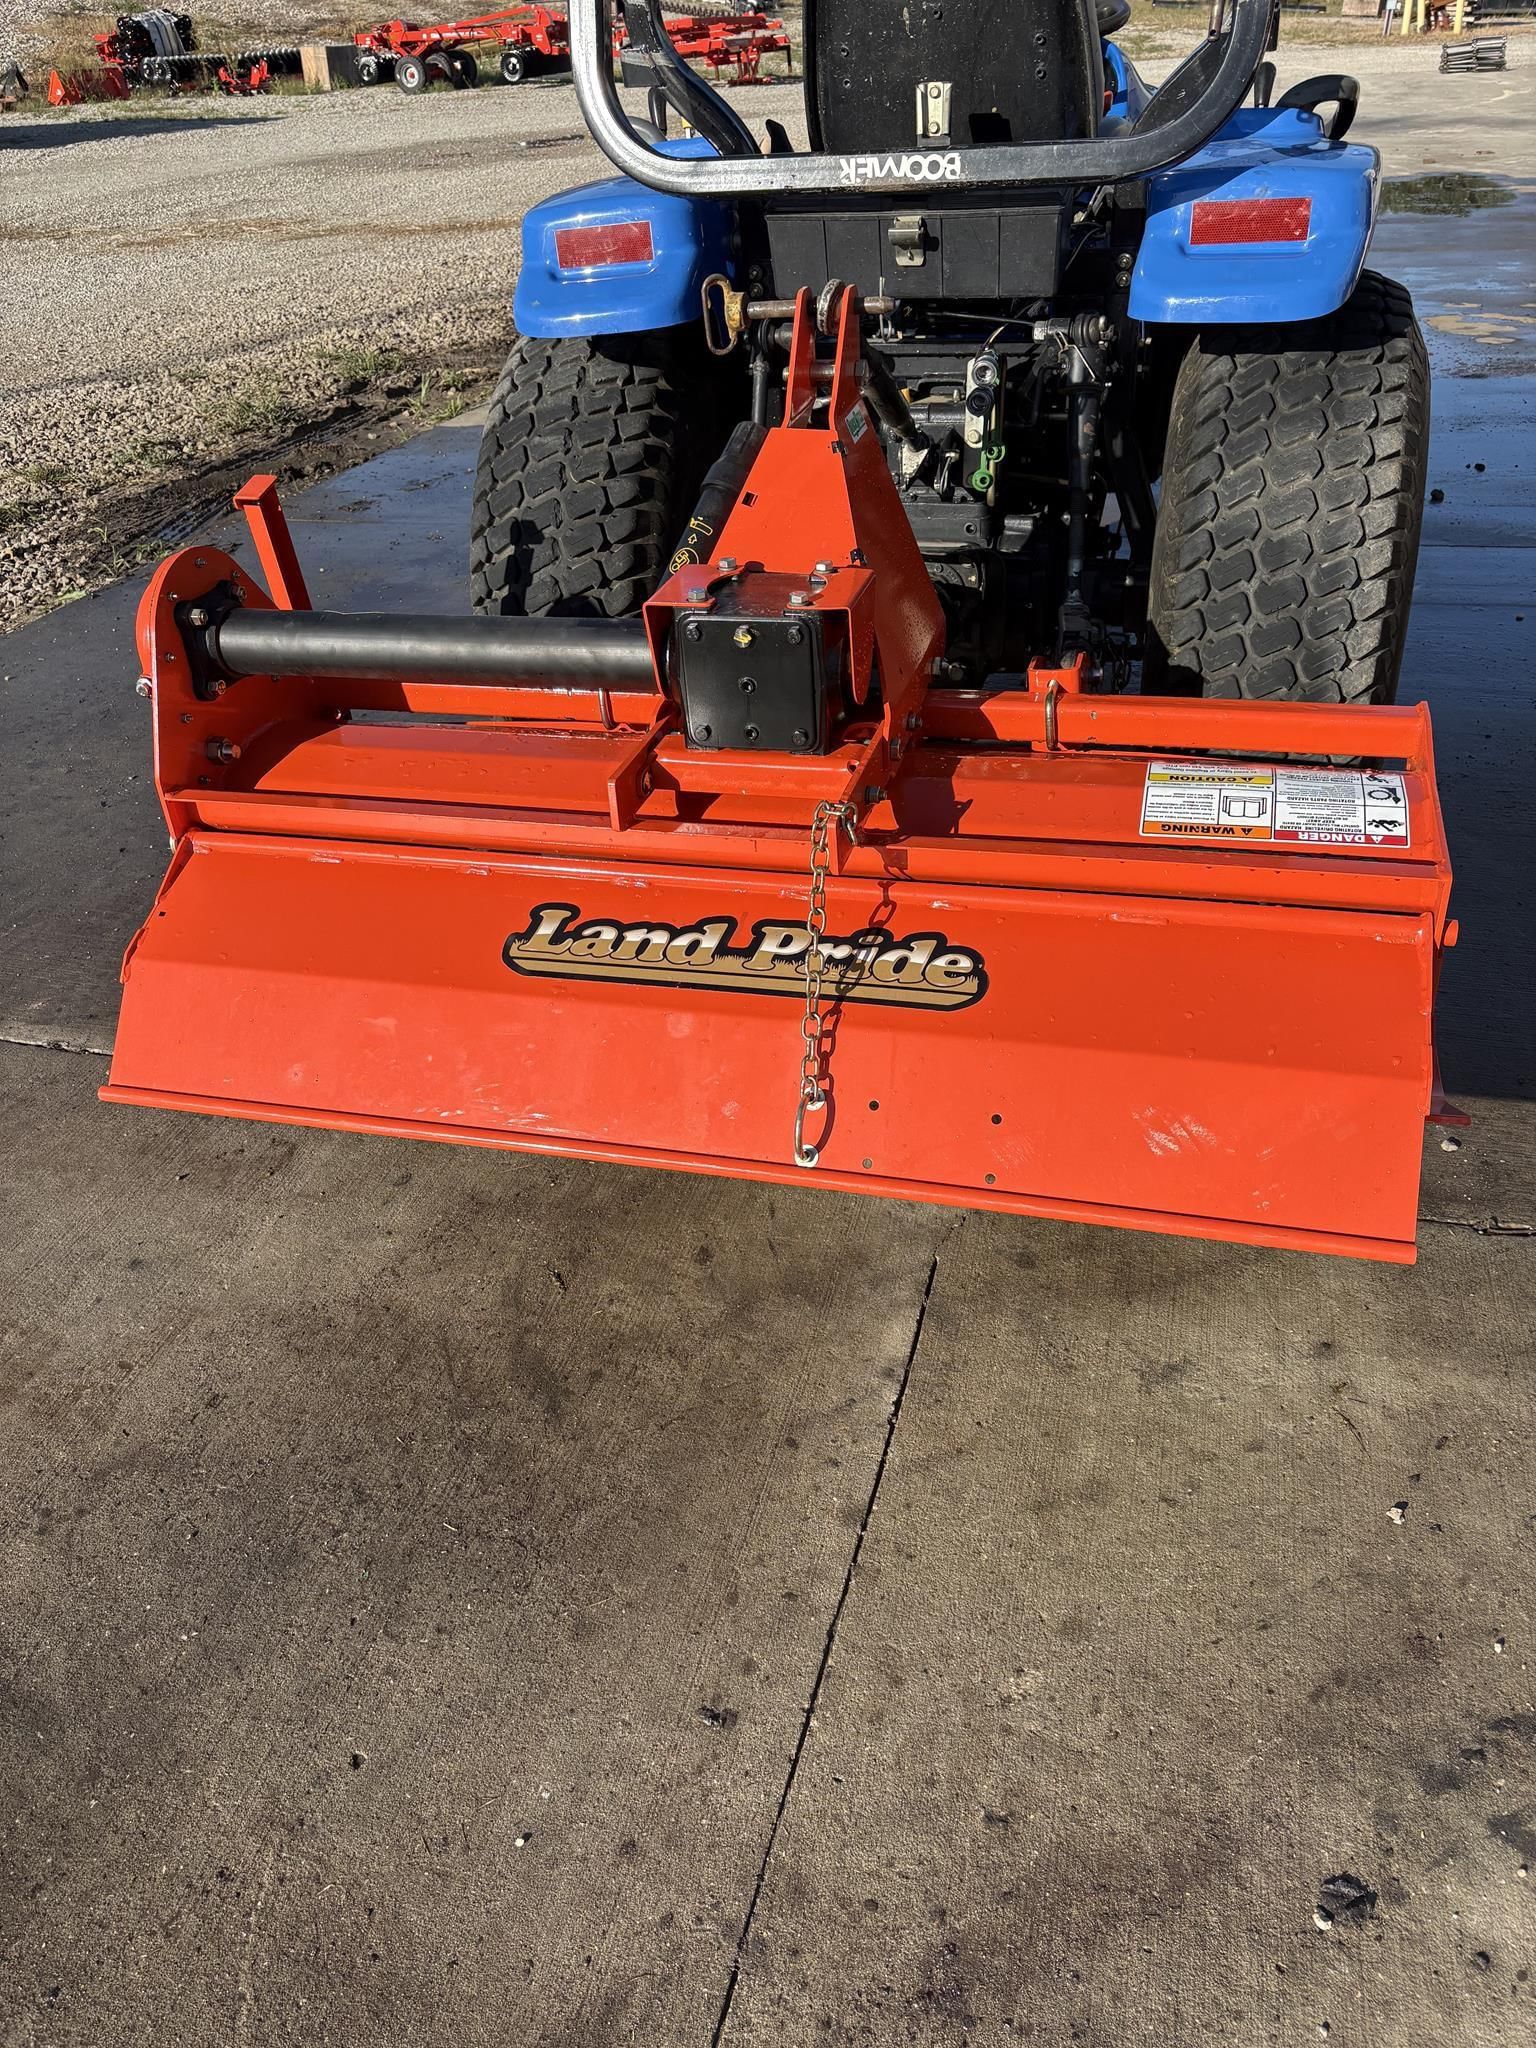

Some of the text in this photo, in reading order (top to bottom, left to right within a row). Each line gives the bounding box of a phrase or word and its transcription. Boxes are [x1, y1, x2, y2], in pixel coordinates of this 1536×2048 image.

[840, 153, 961, 184] BOOMER
[1161, 823, 1236, 835] WARNING
[1298, 832, 1366, 842] DANGER
[517, 907, 974, 987] Land Pride
